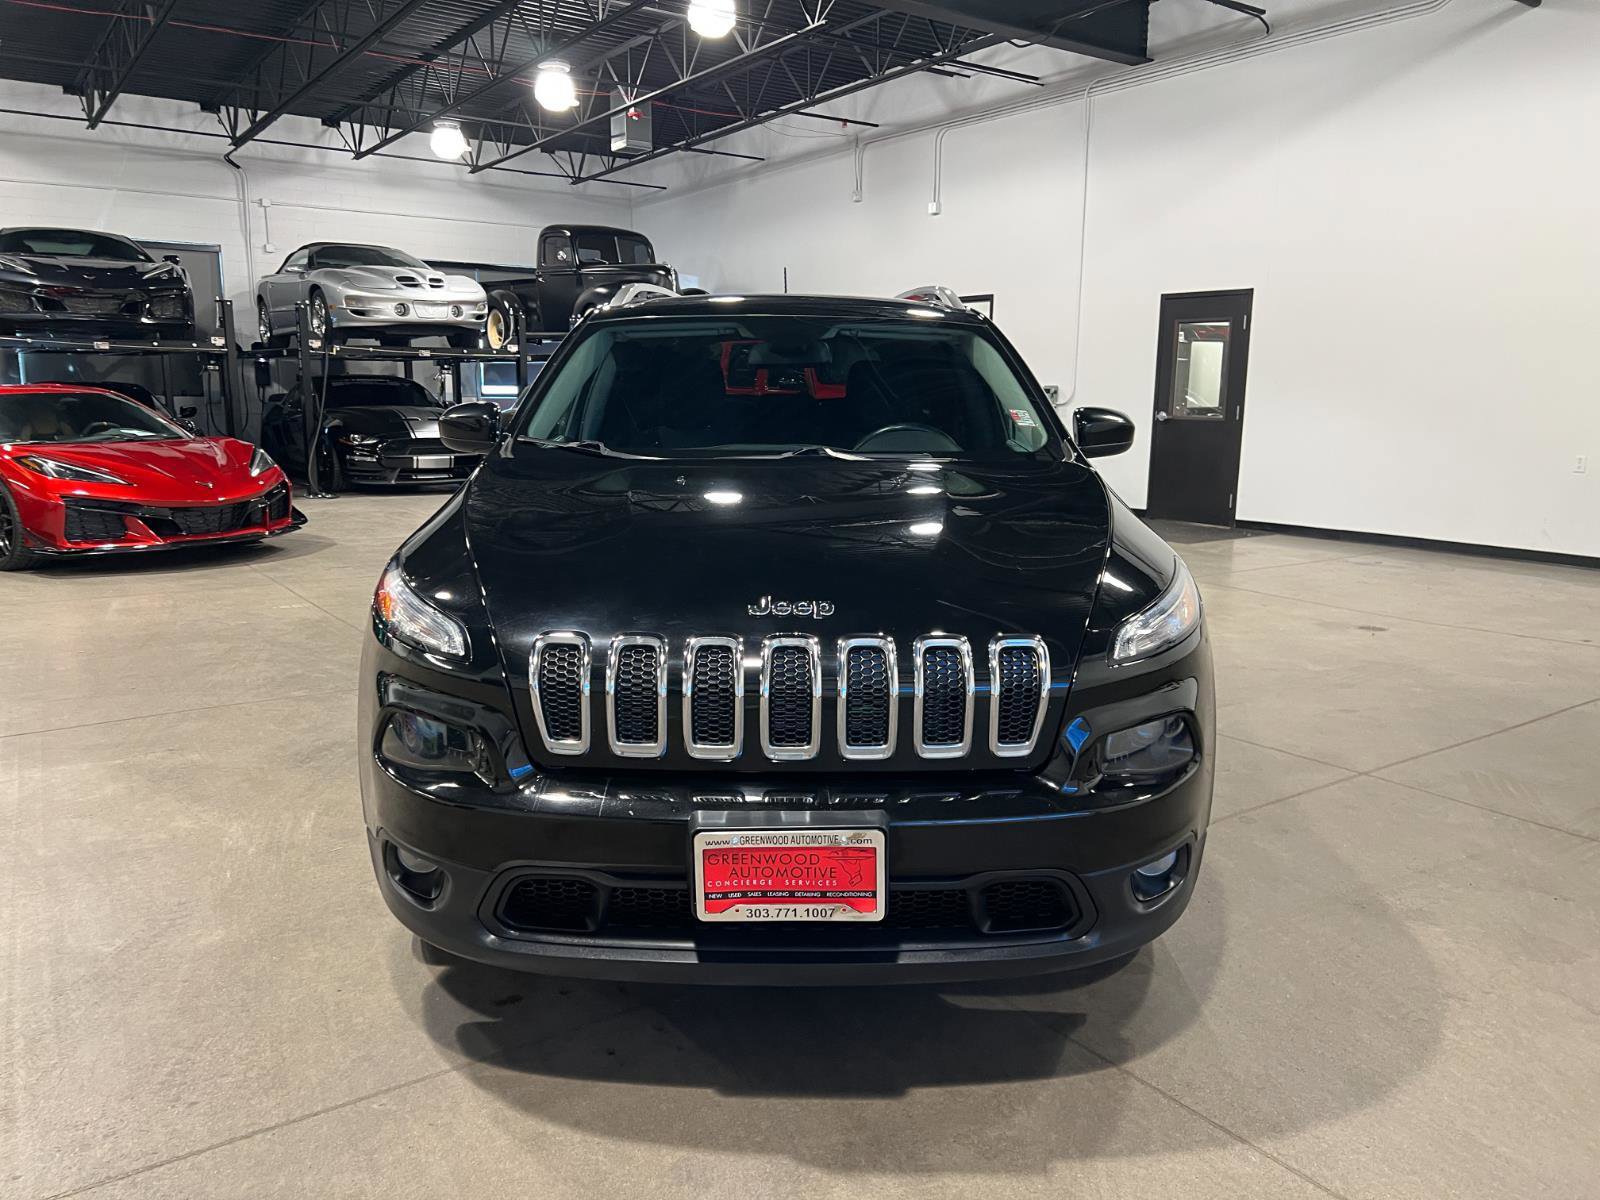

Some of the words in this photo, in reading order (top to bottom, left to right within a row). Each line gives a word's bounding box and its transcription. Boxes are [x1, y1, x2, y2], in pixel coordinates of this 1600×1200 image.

[747, 595, 835, 620] Jeep
[739, 836, 788, 846] GREENWOOD
[790, 834, 839, 845] AUTOMOTIVE
[707, 853, 820, 865] GREENWOOD
[728, 866, 837, 879] AUTOMOTIVE
[707, 879, 773, 887] CONCIERGE
[784, 879, 838, 887] SERVICES
[746, 907, 835, 918] 303.771.1007
